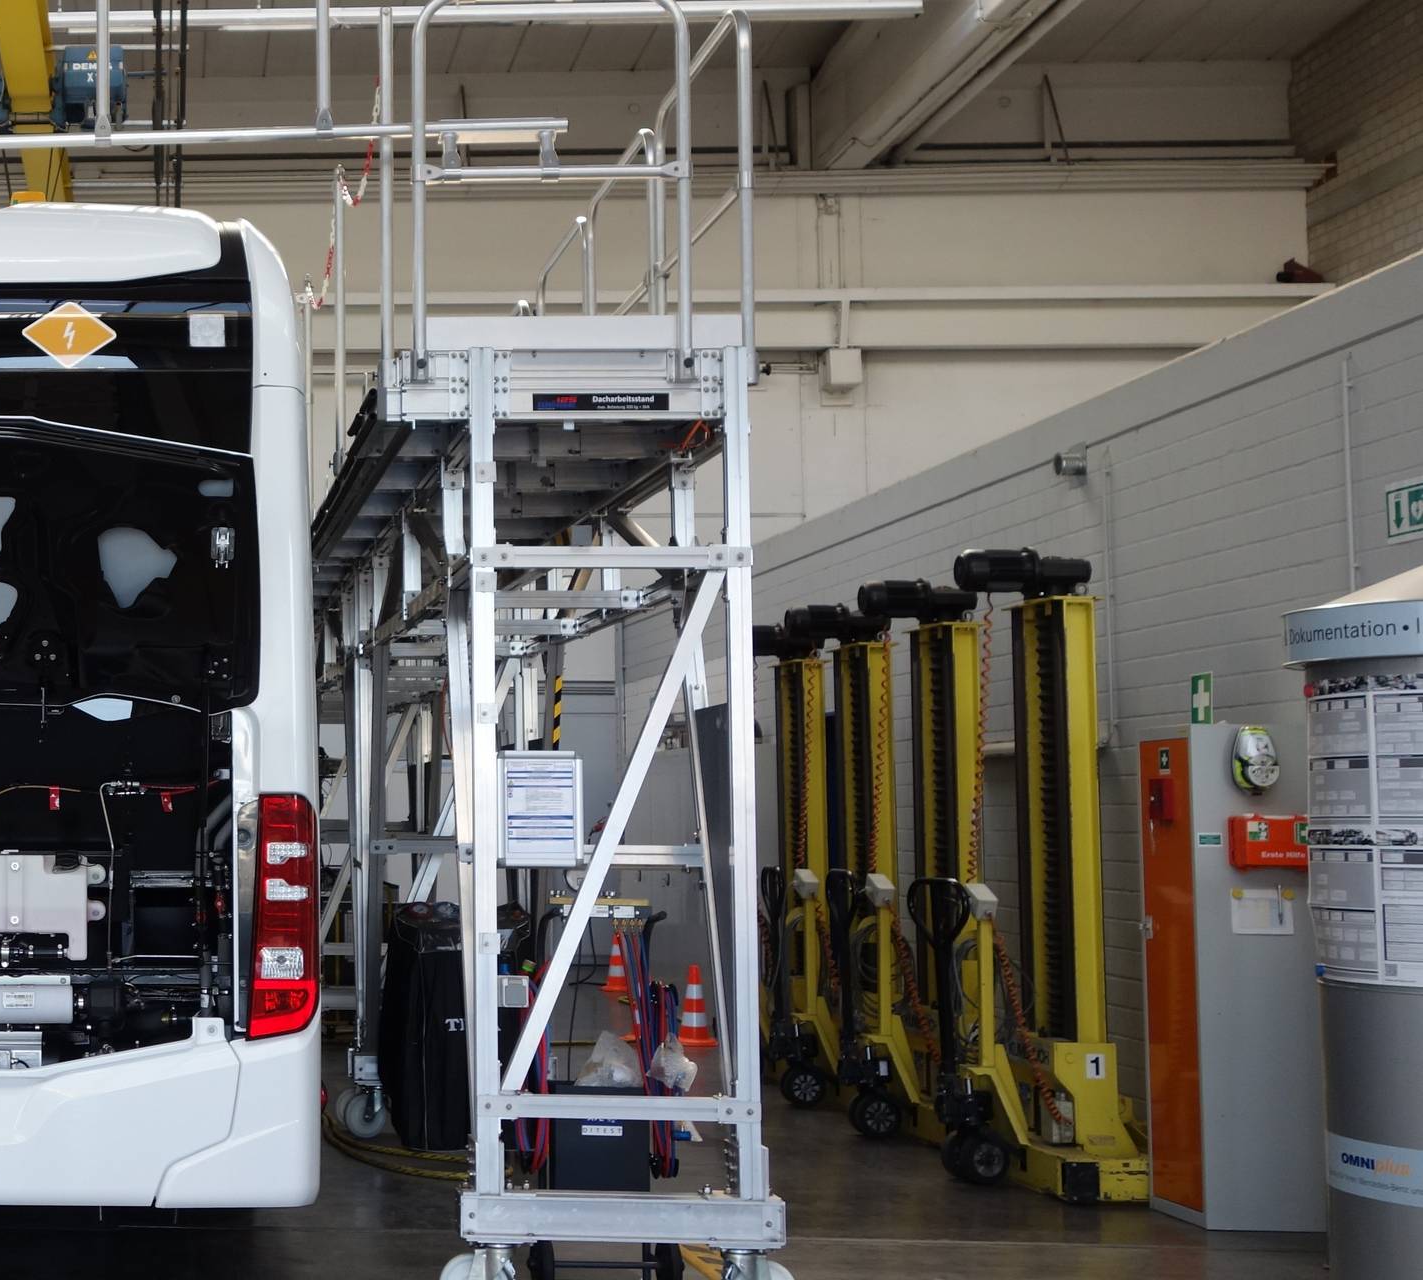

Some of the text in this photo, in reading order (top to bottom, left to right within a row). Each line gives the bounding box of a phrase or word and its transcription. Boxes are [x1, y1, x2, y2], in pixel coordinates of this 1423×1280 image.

[72, 62, 113, 70] DEM
[592, 395, 655, 403] Dacharbeitsstand
[1288, 620, 1397, 645] Dokumentation
[1090, 1055, 1101, 1077] 1
